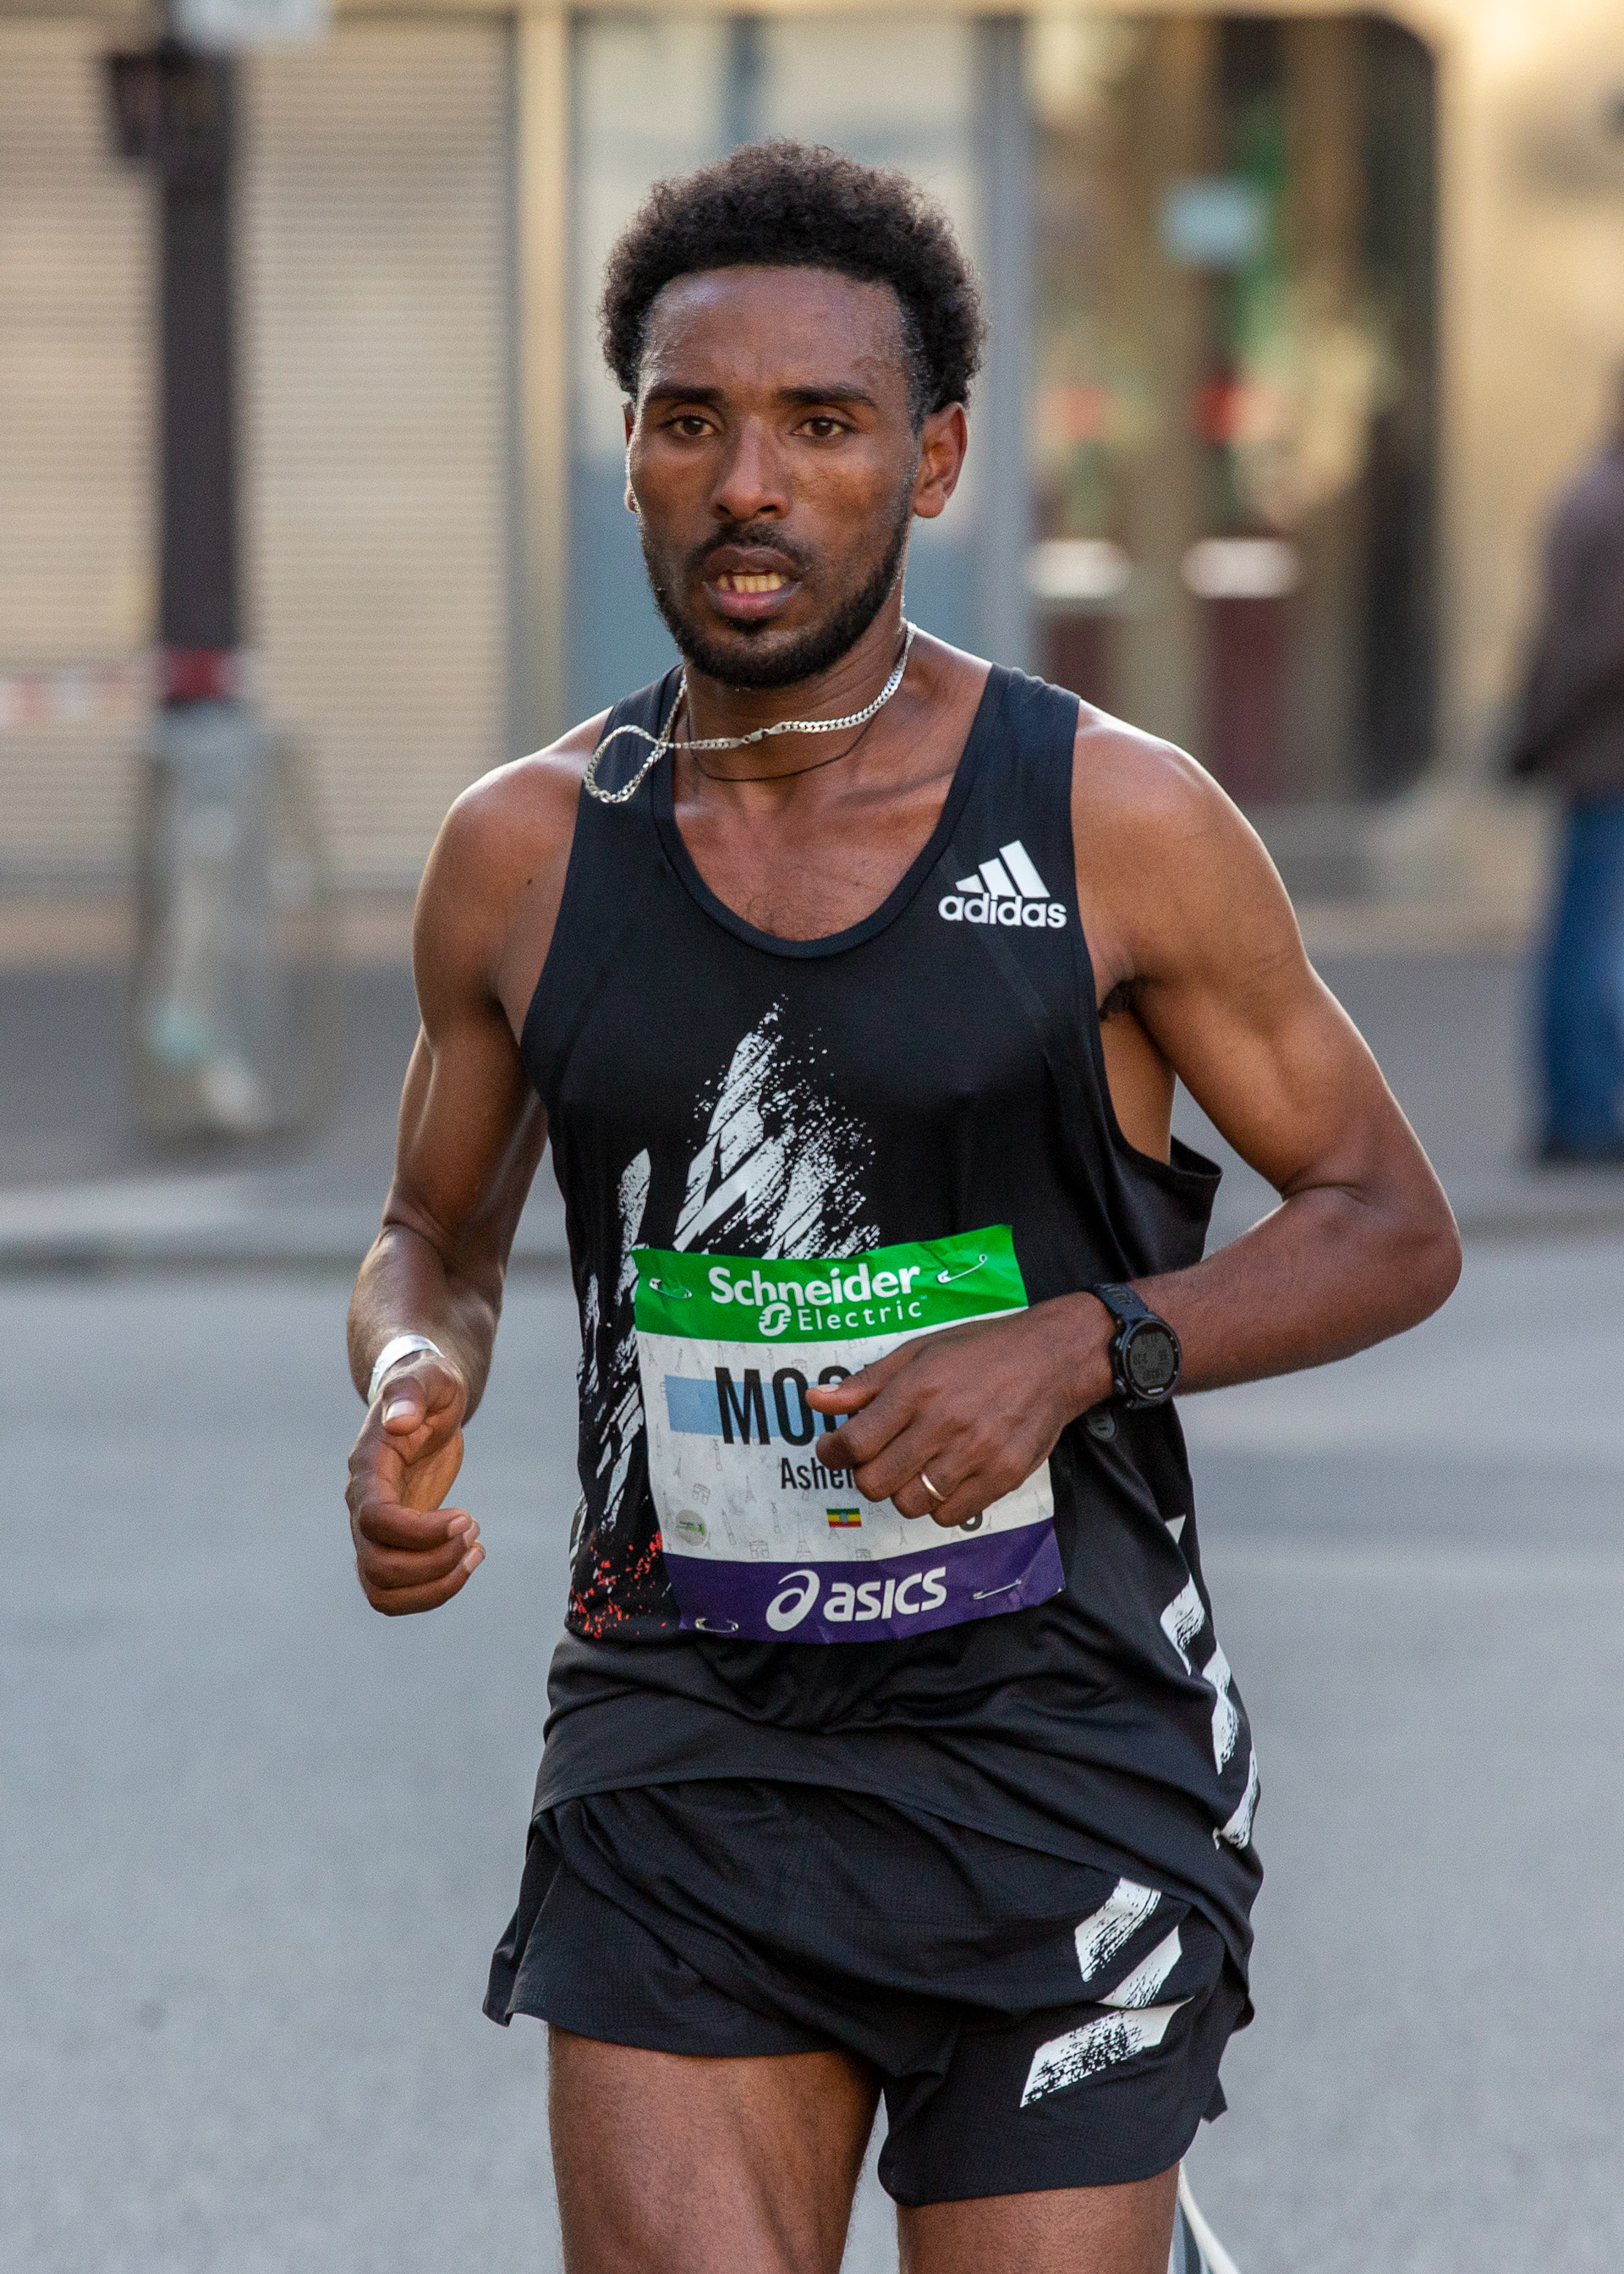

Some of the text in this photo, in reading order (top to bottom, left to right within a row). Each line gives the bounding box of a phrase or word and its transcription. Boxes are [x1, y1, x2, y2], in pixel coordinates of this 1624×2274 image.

[938, 893, 1067, 929] adidas
[708, 1263, 920, 1306] Schneider
[798, 1300, 922, 1331] Electric
[715, 1365, 868, 1446] MO
